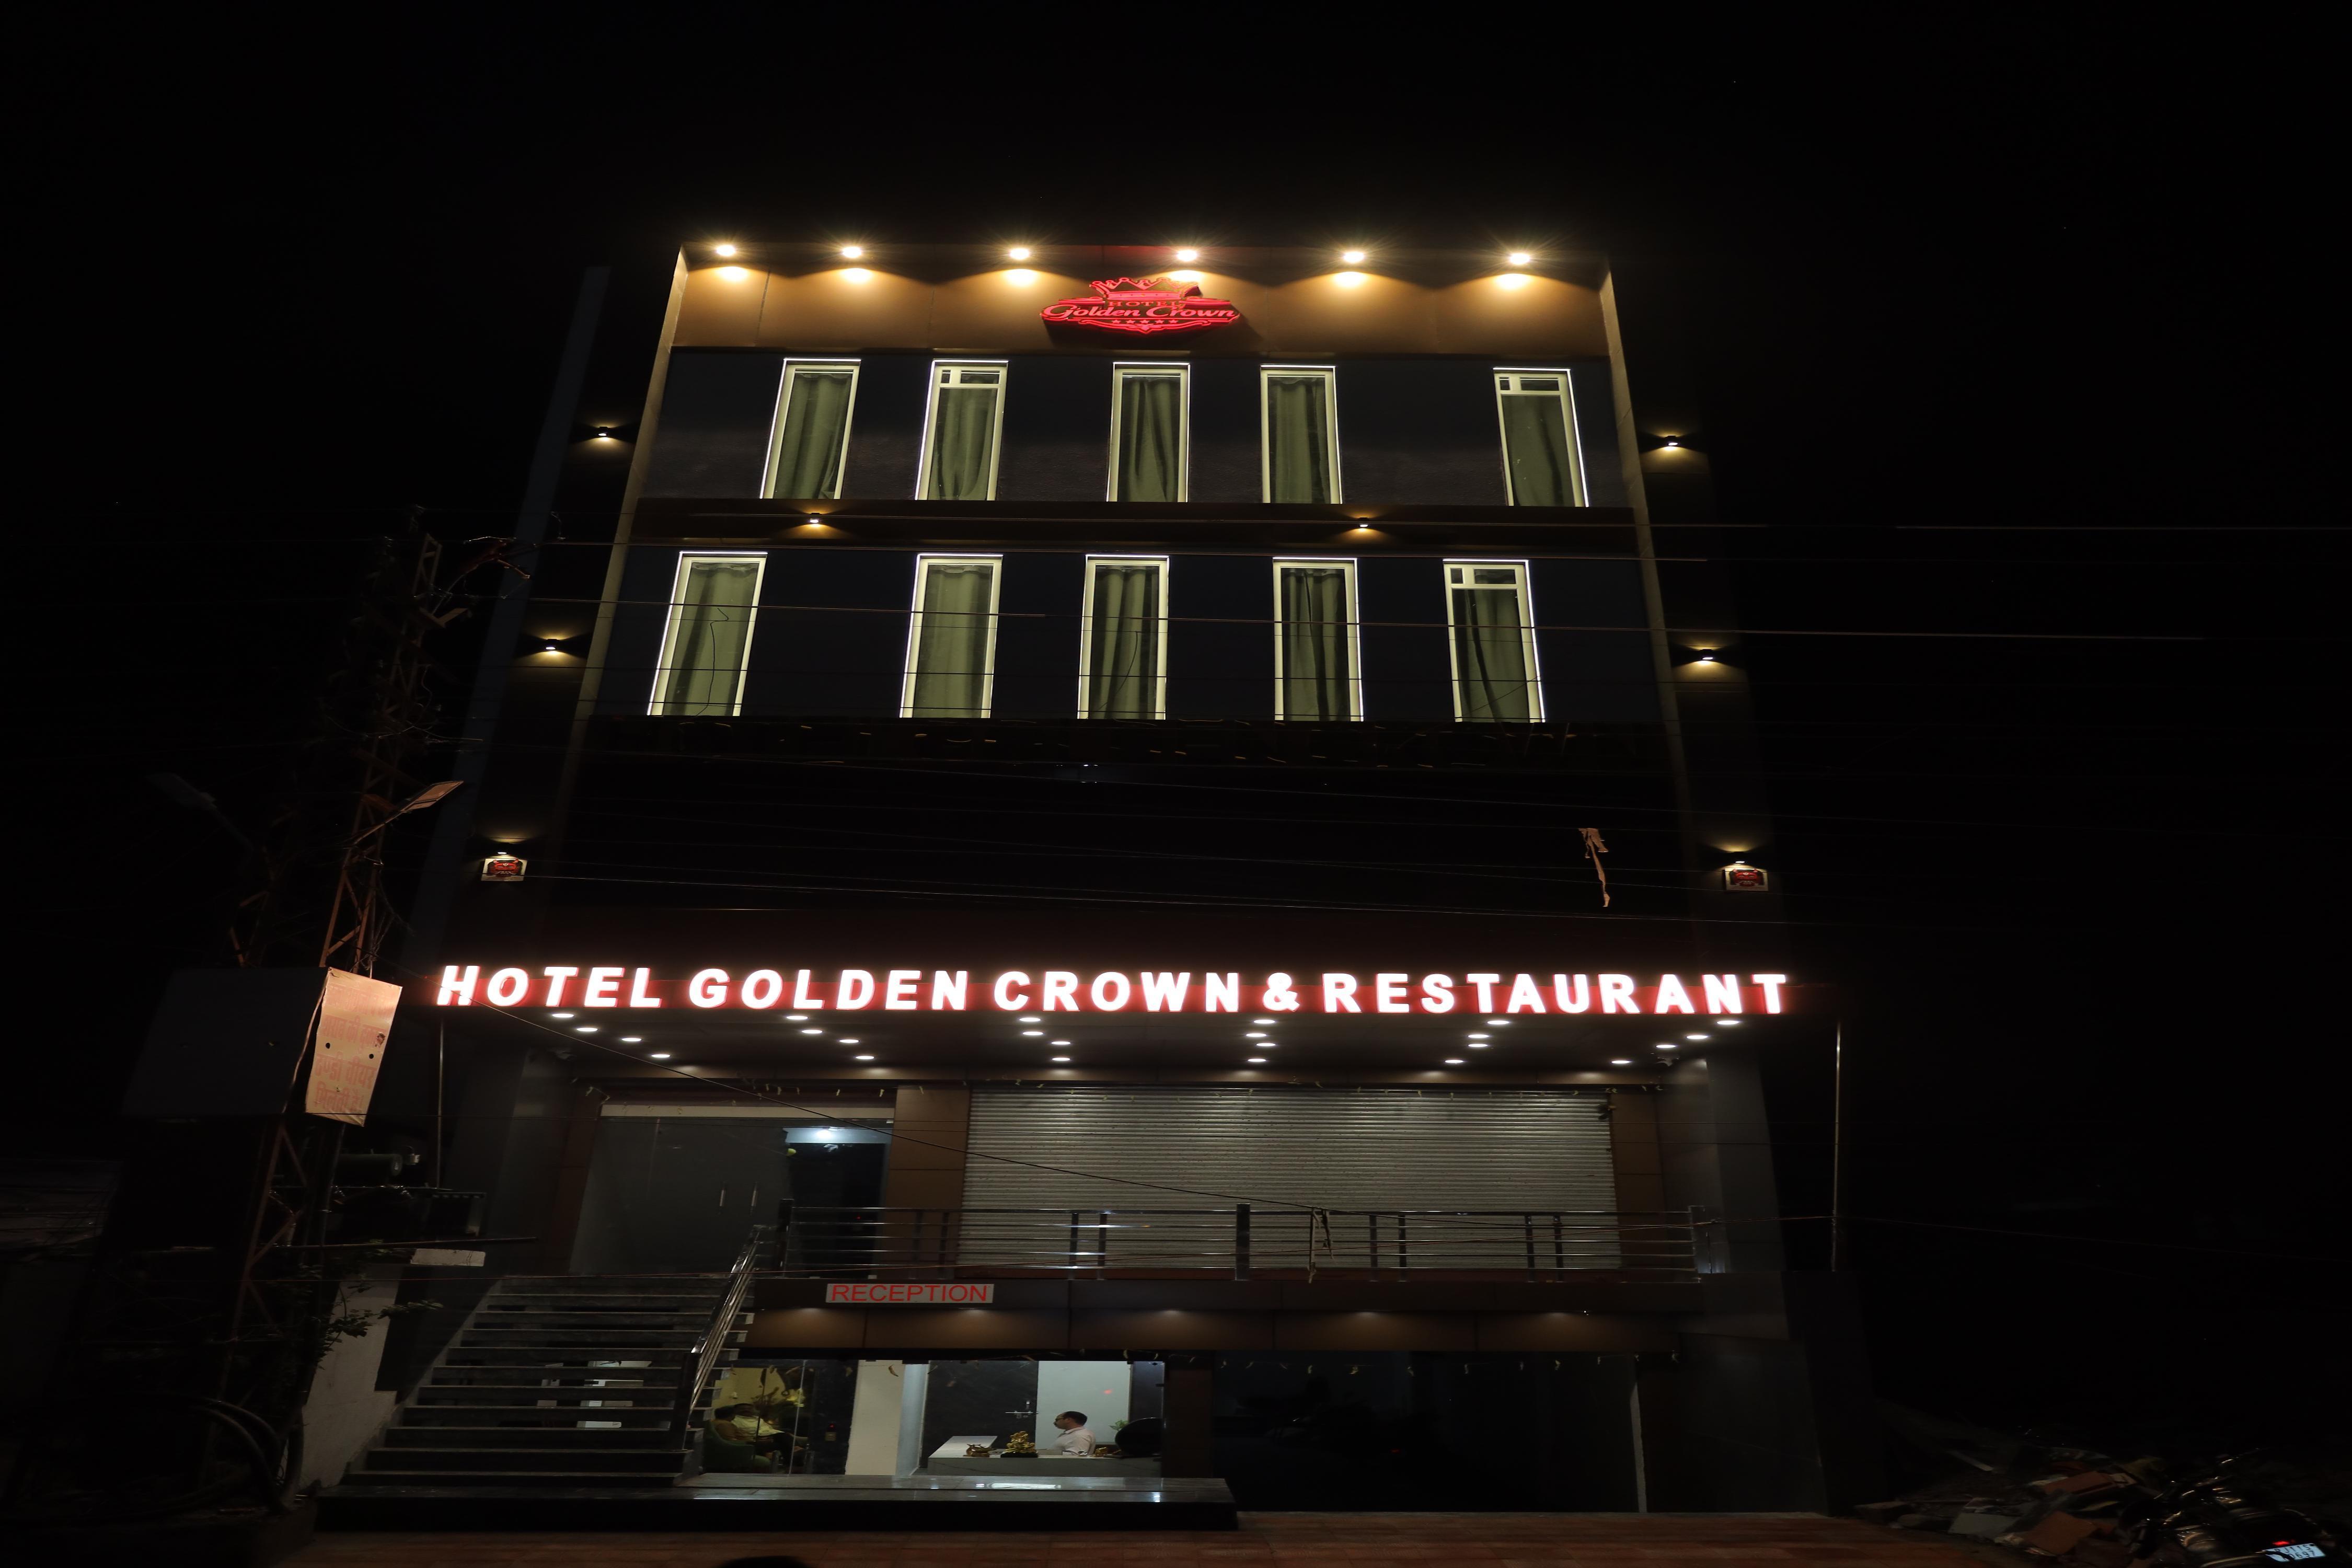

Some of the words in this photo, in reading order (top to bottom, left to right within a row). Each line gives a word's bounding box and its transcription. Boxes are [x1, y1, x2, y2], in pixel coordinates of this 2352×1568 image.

[1043, 304, 1140, 318] Golden
[1146, 306, 1235, 317] Crown
[436, 965, 662, 1007] HOTEL
[688, 968, 969, 1010] GOLDEN
[993, 971, 1240, 1012] CROWN
[1261, 972, 1300, 1012] &
[1322, 973, 1786, 1014] RESTAURANT
[832, 1285, 987, 1301] RECEPTION
